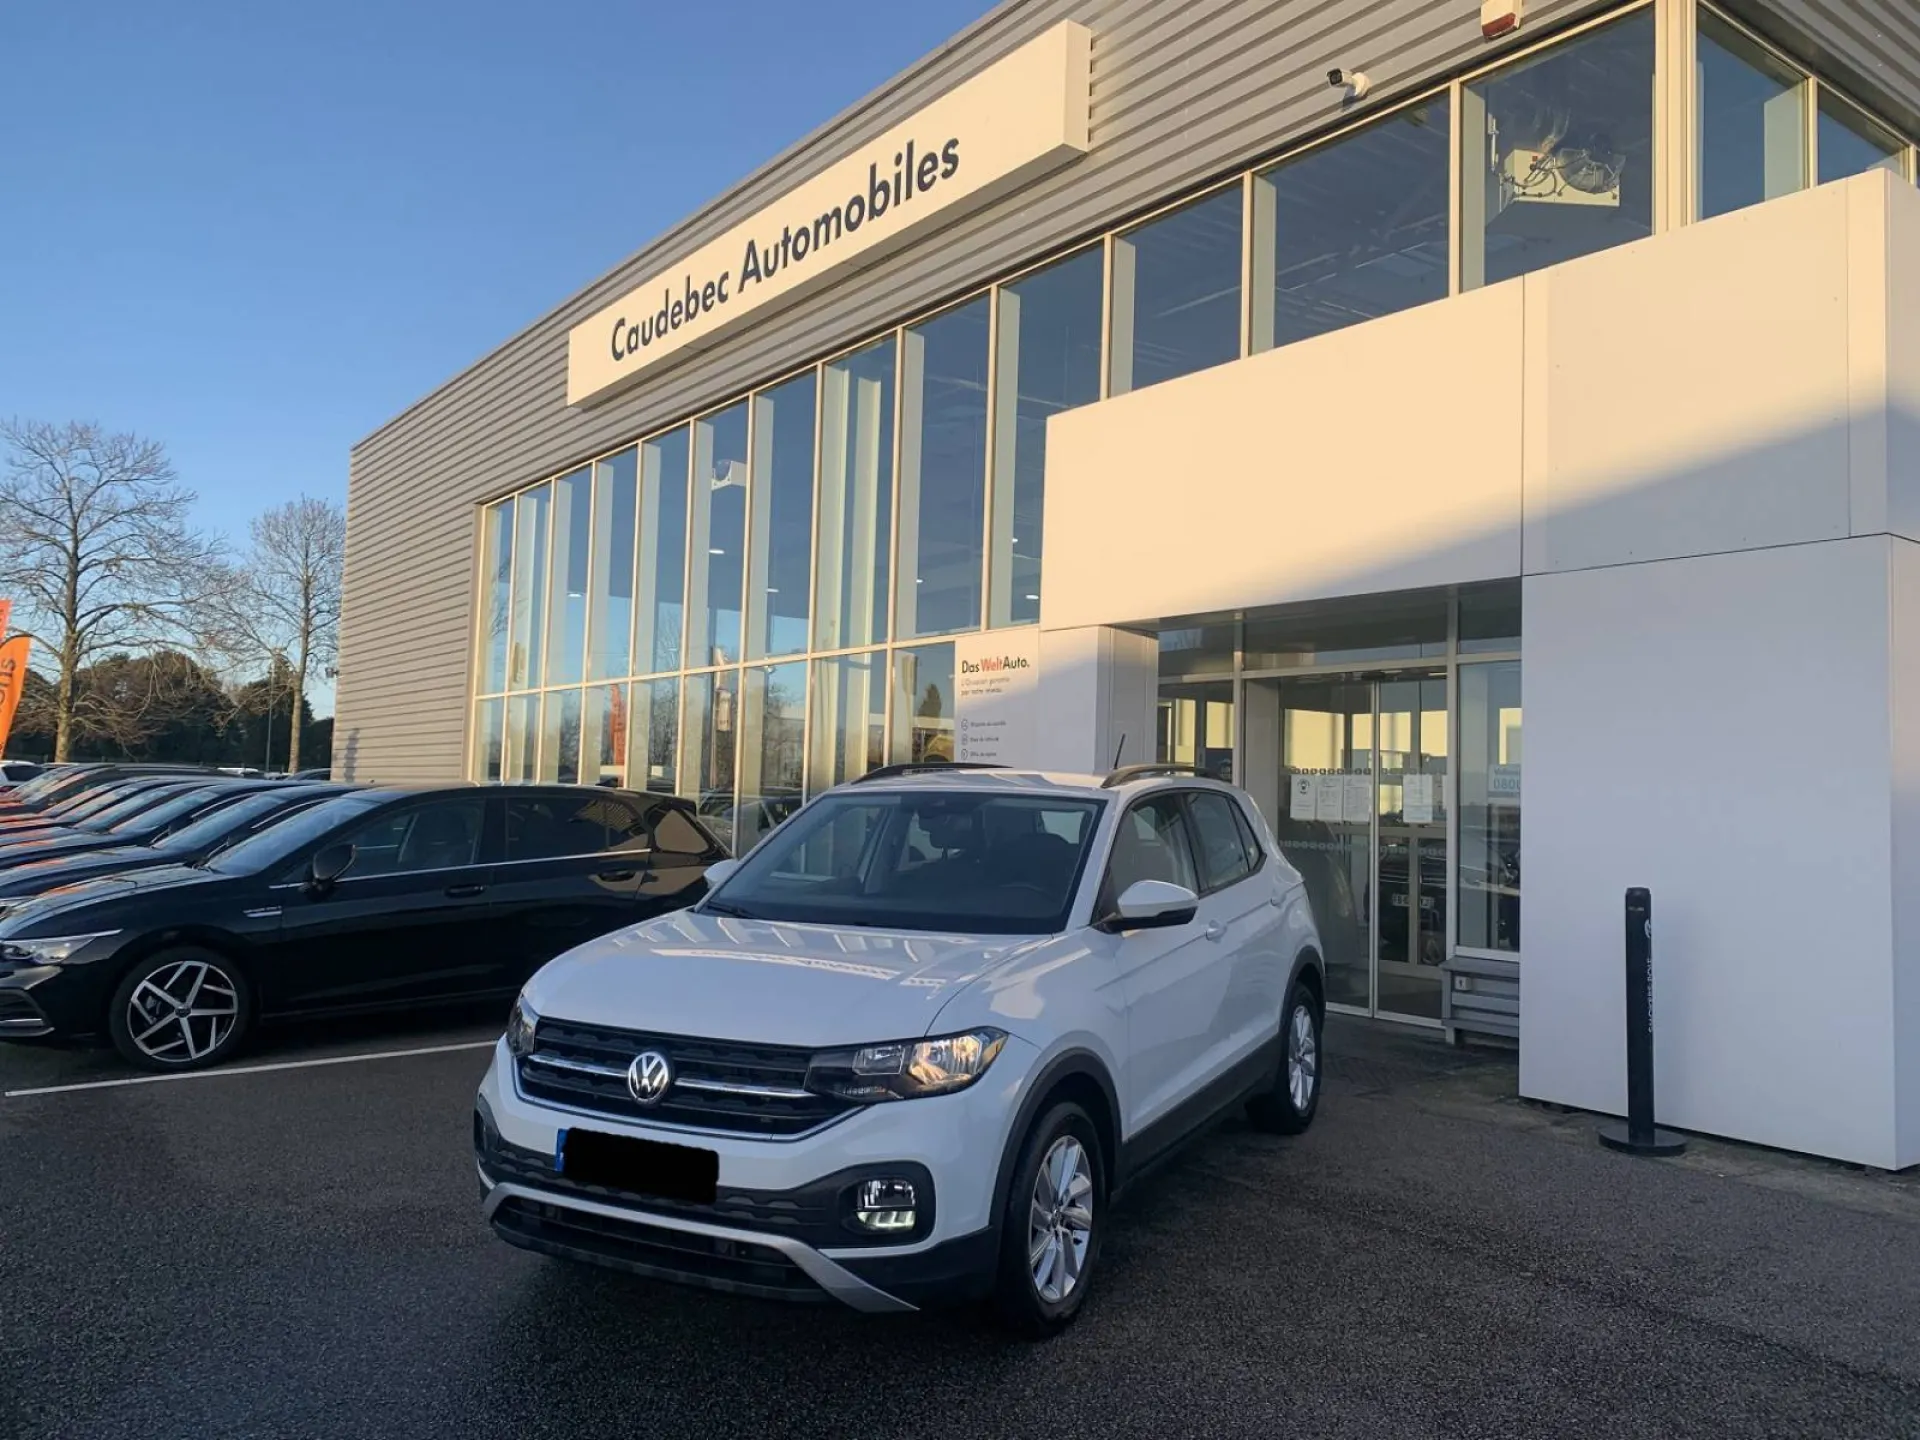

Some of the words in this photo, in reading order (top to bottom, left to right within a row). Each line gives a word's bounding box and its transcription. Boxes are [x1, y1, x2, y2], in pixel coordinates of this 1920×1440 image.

[611, 270, 729, 361] Caudebec
[738, 137, 960, 294] Automobiles
[962, 660, 979, 673] Das
